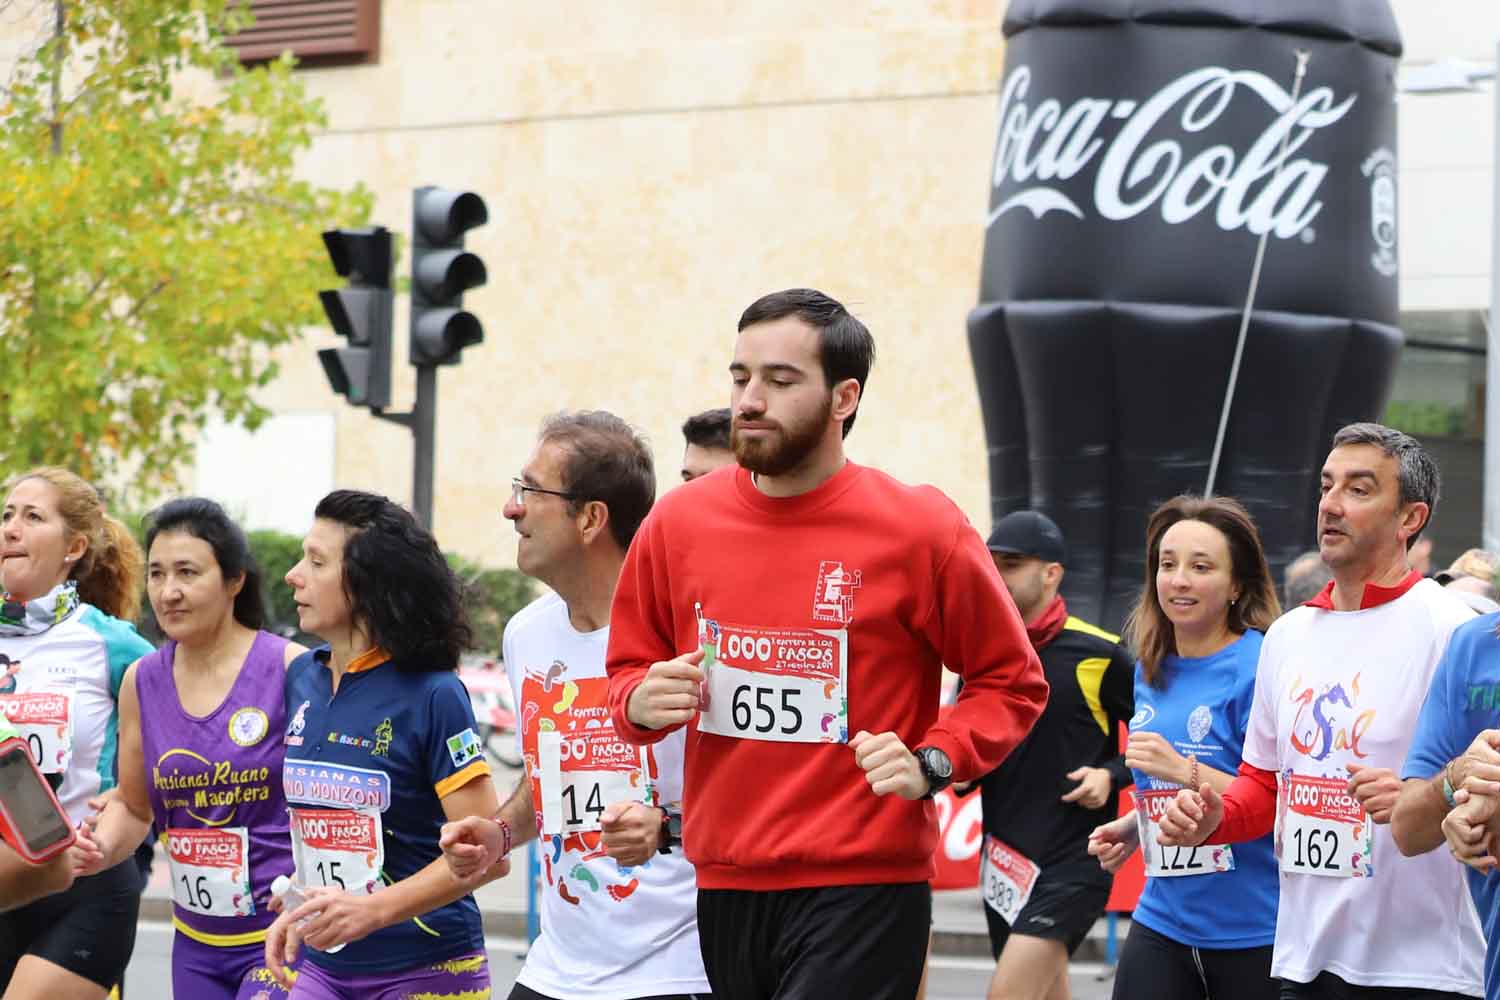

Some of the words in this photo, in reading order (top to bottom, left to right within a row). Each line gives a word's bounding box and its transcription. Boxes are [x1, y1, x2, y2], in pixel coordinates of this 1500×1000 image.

[715, 633, 772, 662] 1.000
[778, 646, 832, 662] PASOS
[731, 684, 803, 735] 655
[212, 760, 268, 786] Ruano
[194, 786, 269, 808] Macotera
[561, 782, 605, 825] 14
[1287, 783, 1319, 807] 1.000
[1293, 828, 1340, 870] 162
[316, 861, 345, 892] 15
[181, 874, 213, 910] 16
